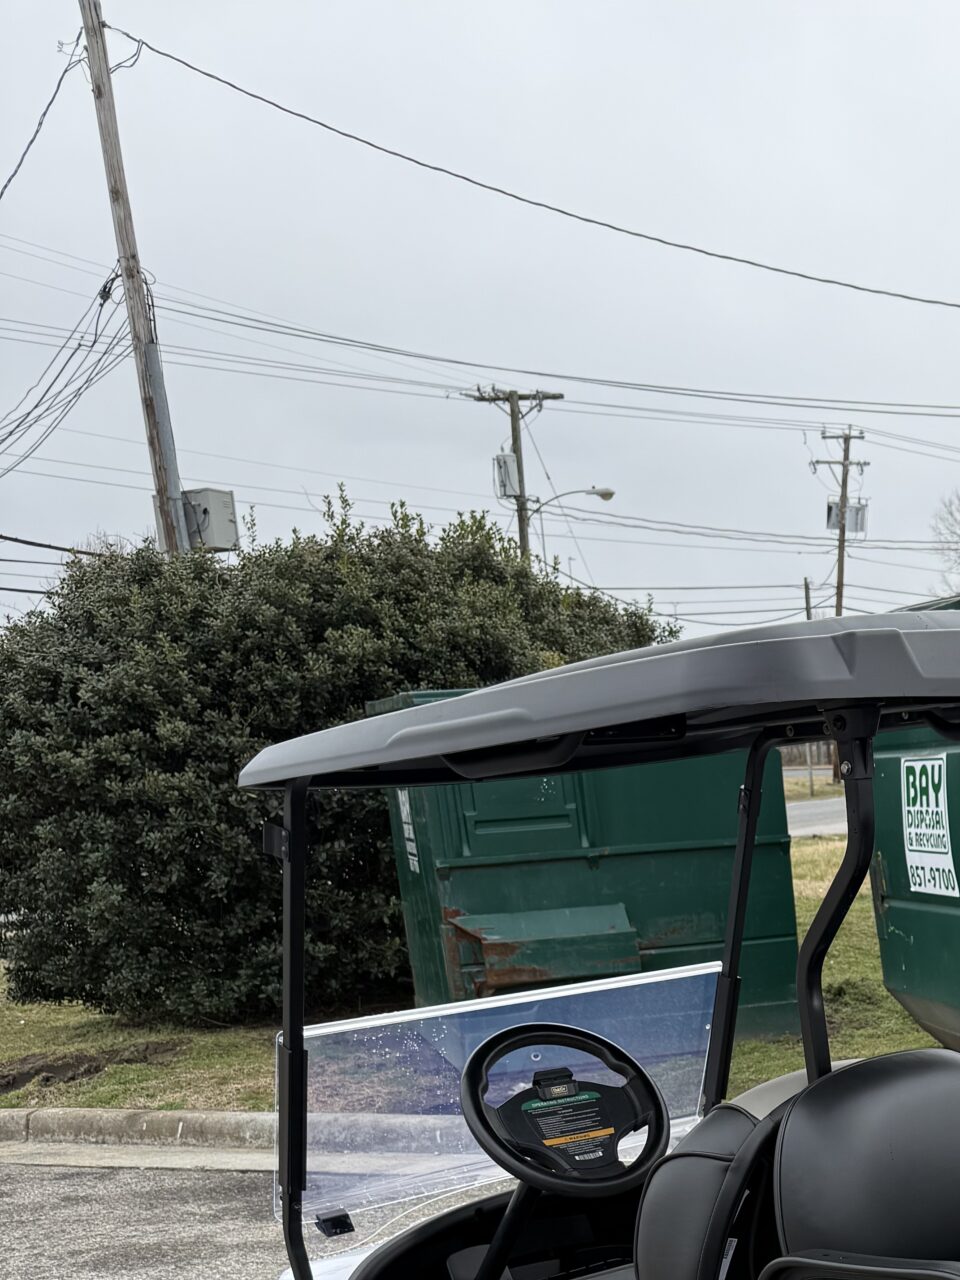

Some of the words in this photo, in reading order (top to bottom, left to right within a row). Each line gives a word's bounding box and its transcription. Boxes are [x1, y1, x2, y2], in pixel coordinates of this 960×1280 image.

[905, 764, 942, 808] BAY
[907, 810, 945, 830] DISPOSAL
[915, 832, 946, 849] RECYCLING
[910, 865, 956, 891] 857-9700
